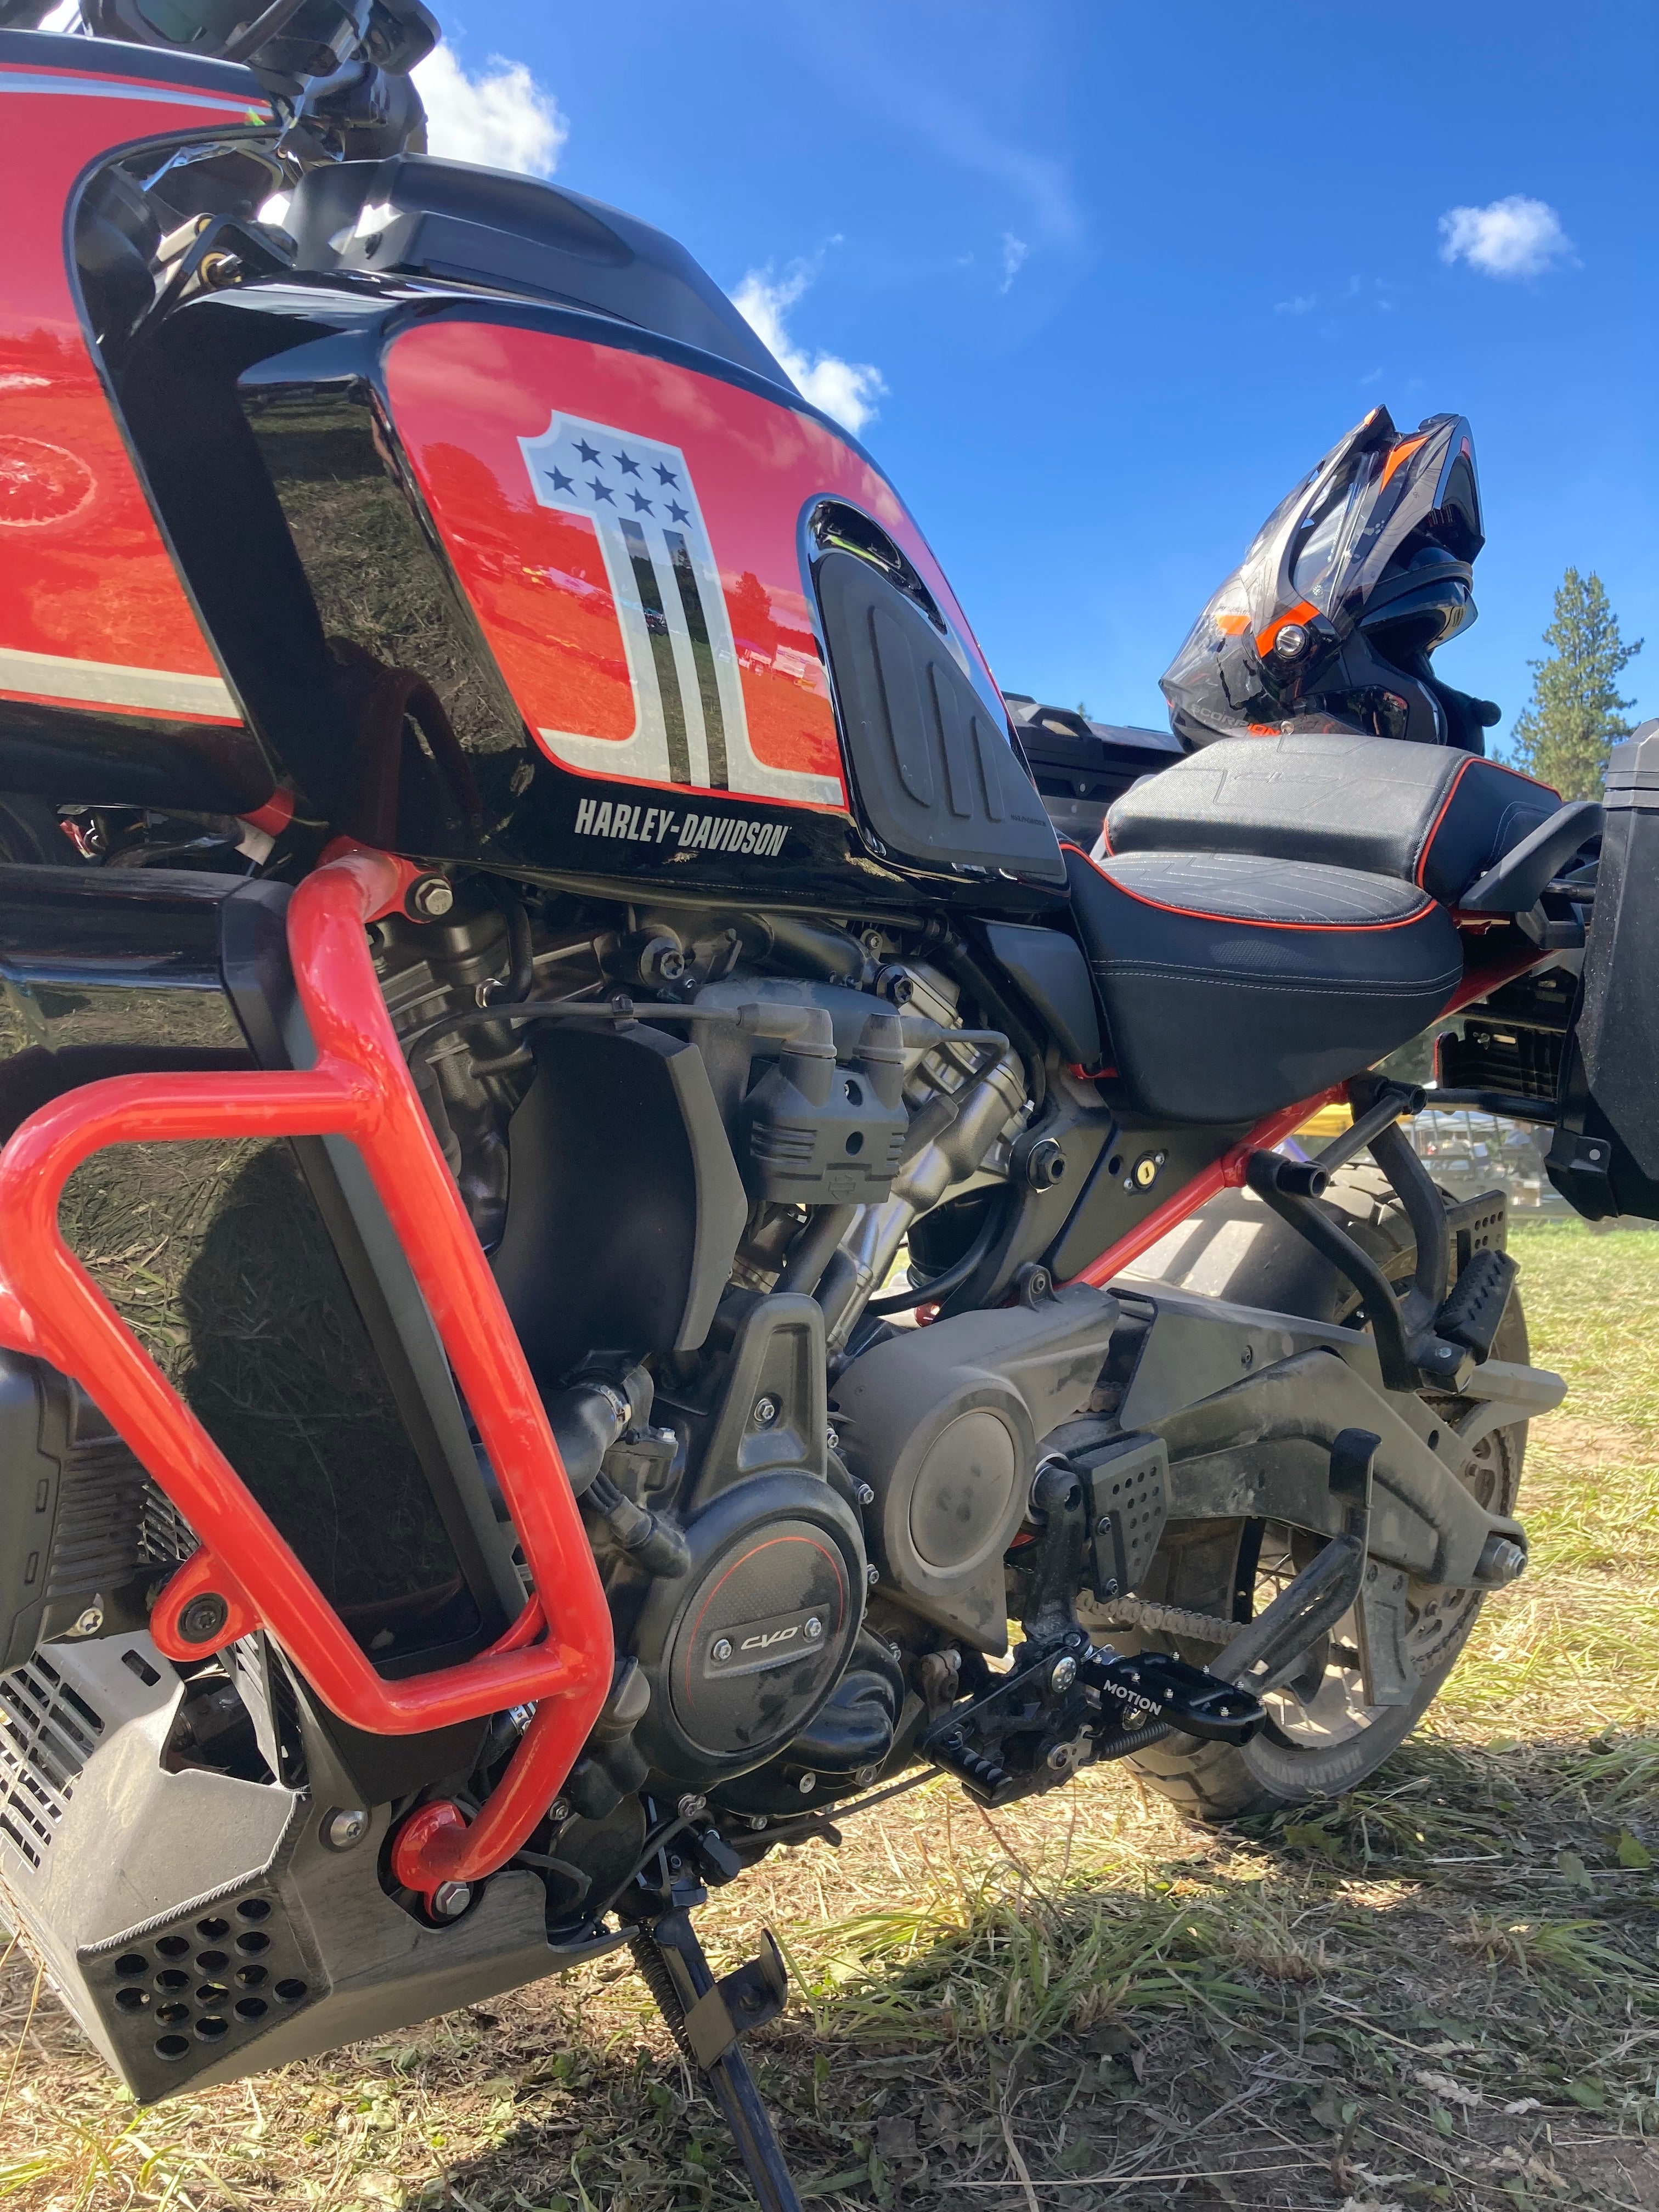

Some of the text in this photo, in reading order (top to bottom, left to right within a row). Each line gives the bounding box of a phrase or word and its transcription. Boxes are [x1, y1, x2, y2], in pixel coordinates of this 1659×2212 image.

[1190, 703, 1281, 737] SCORPION
[574, 798, 791, 857] HARLEY-DAVIDSON
[741, 1627, 798, 1650] CVO
[1103, 1679, 1162, 1716] MOTION
